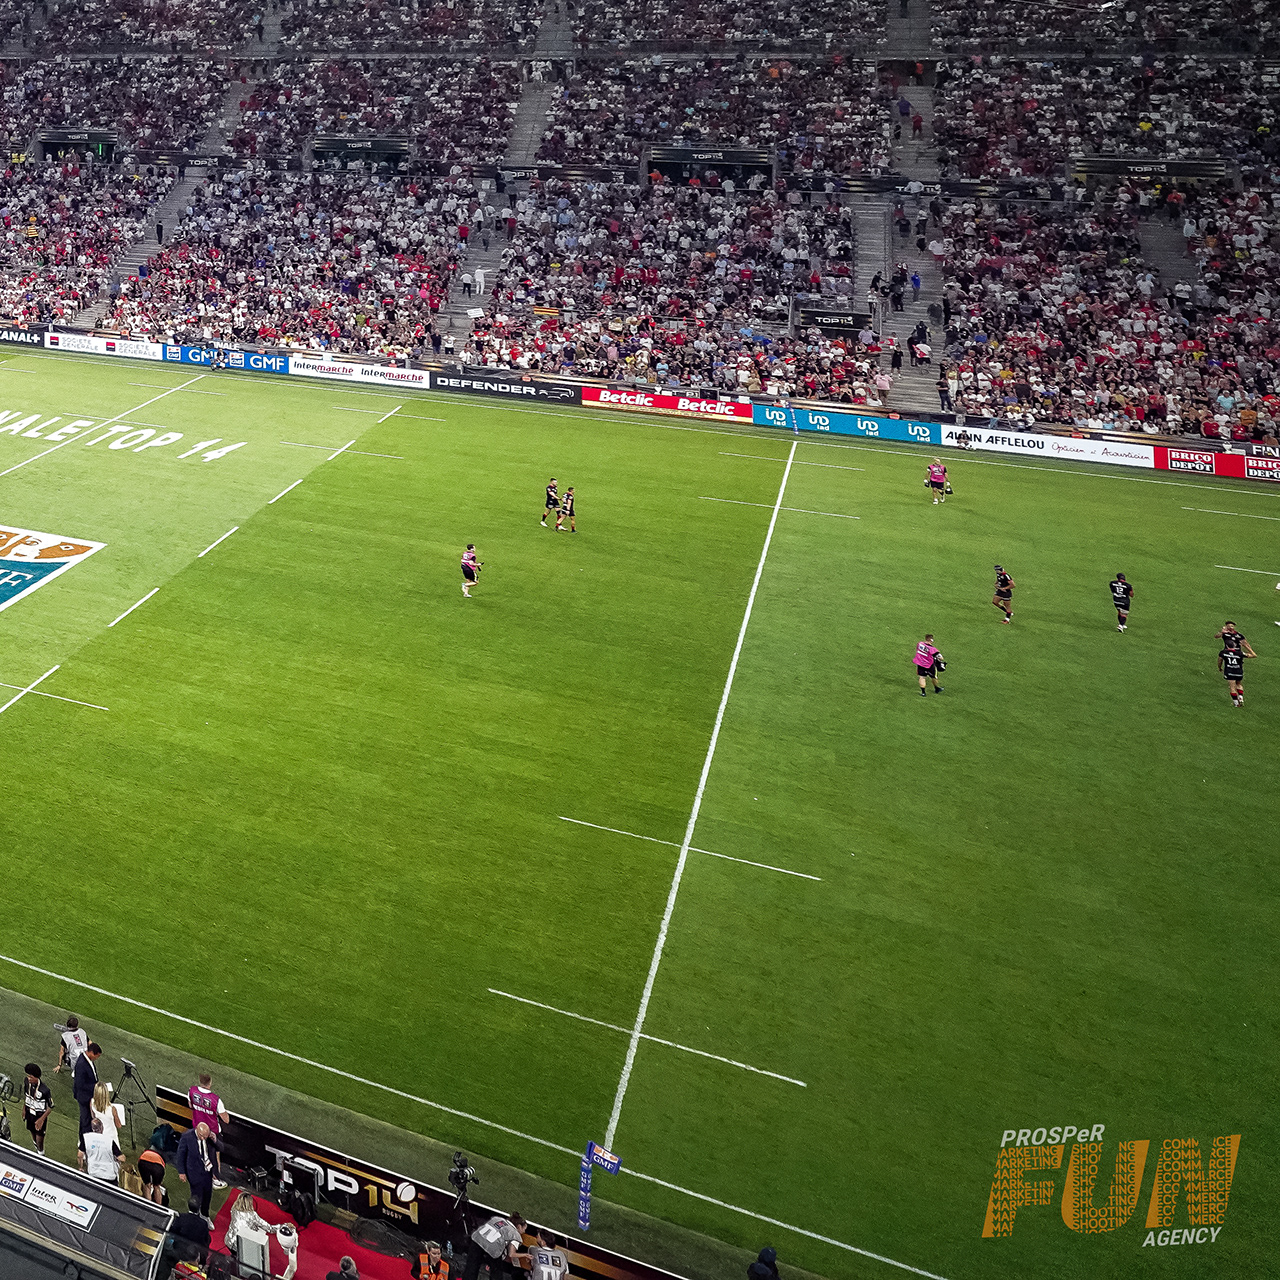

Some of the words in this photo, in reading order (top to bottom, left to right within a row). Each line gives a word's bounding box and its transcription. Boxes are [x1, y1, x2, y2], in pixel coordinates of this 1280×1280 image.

[250, 355, 285, 370] GMF
[436, 377, 537, 396] DEFENDER
[600, 391, 654, 407] Betclic
[678, 398, 735, 415] Betclic
[85, 425, 184, 453] TOP
[176, 438, 248, 462] 14
[986, 435, 1044, 450] AFFLELOU
[1170, 450, 1212, 463] BRICO
[593, 1153, 615, 1171] GMF
[0, 1178, 23, 1193] GMF
[381, 1207, 403, 1221] RUGBY
